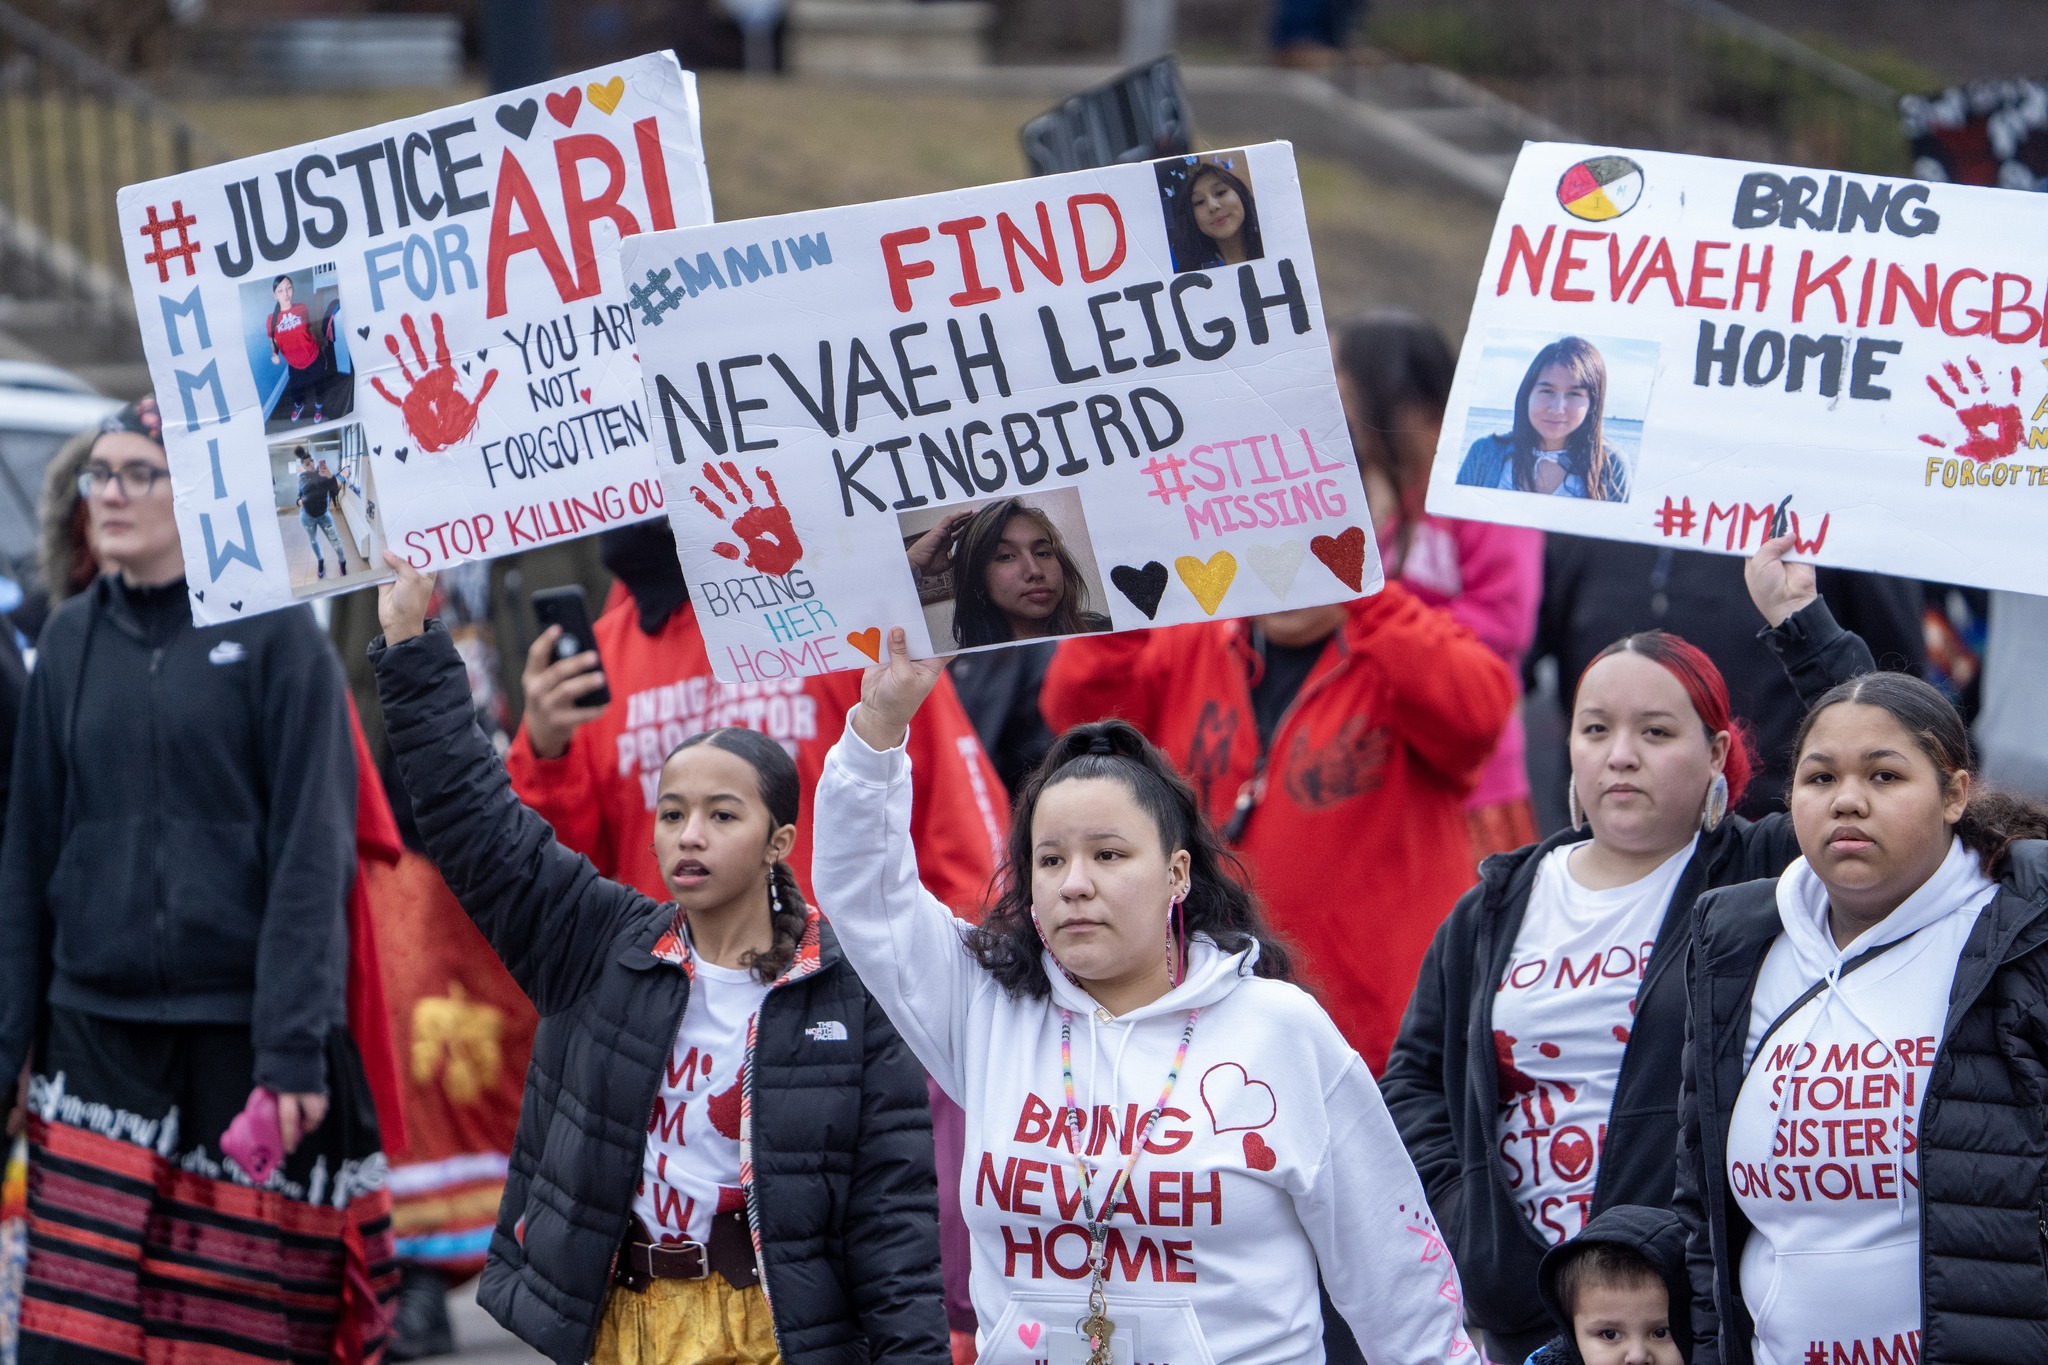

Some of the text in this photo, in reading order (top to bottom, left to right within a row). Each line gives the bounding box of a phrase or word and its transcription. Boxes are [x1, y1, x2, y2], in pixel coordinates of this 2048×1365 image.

[486, 116, 675, 320] ARI
[1732, 171, 1940, 237] BRING
[364, 223, 478, 312] FOR
[629, 231, 833, 327] #MMIW
[880, 192, 1127, 313] FIND
[1497, 224, 1774, 312] NEVAEH
[503, 314, 578, 375] YOU
[656, 258, 1312, 464] NEVAEH LEIGH
[1694, 319, 1903, 400] HOME
[527, 367, 582, 412] NOT
[481, 400, 649, 488] FORGOTTEN
[831, 387, 1185, 518] KINGBIRD
[1140, 428, 1346, 505] #STILL
[405, 514, 494, 569] STOP
[504, 484, 625, 546] KILLING
[1184, 478, 1347, 541] MISSING
[701, 569, 815, 617] BRING
[763, 600, 838, 643] HER
[726, 635, 849, 683] HOME
[1764, 1036, 1936, 1072] NO MORE
[1013, 1092, 1193, 1156] BRING
[1769, 1072, 1915, 1112] STOLEN
[1773, 1115, 1918, 1158] SISTERS
[975, 1151, 1222, 1227] NEVAEH
[1731, 1160, 1773, 1199] ON
[1000, 1223, 1197, 1284] HOME
[1804, 1329, 1921, 1365] #MMI
